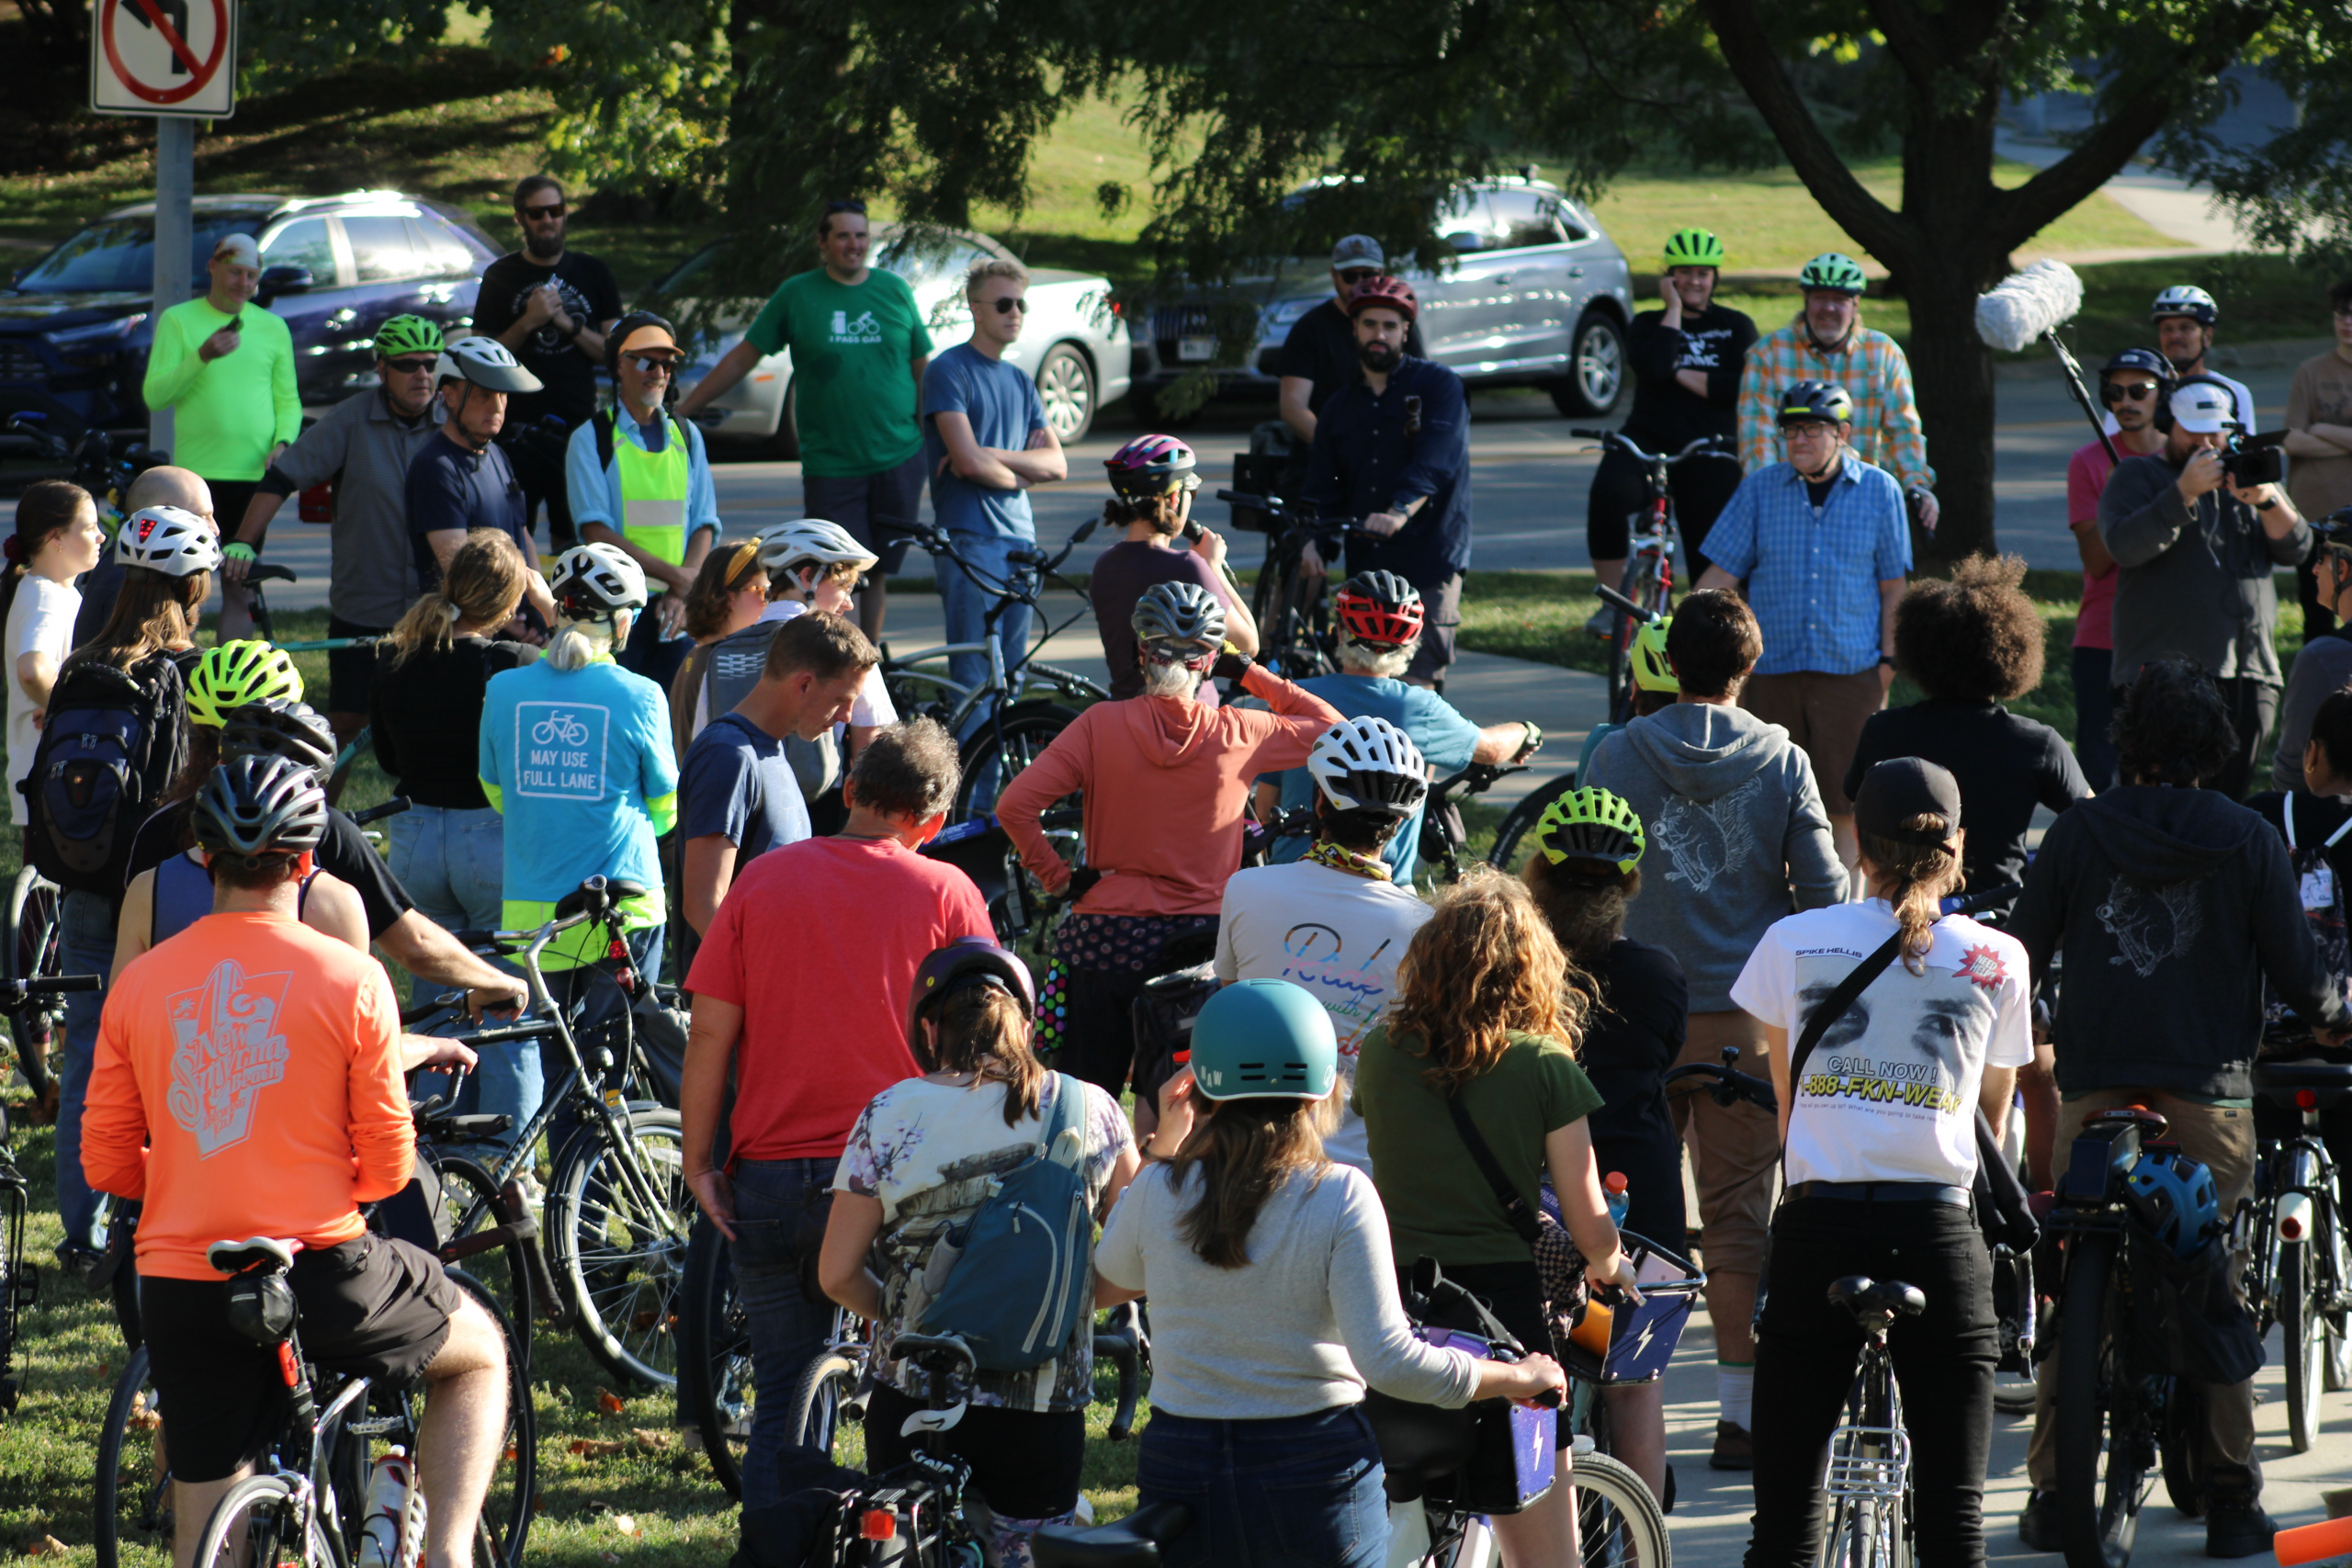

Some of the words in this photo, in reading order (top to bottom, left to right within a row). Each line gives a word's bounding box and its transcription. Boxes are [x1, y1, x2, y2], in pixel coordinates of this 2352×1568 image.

[836, 335, 860, 344] PASS
[862, 335, 882, 344] GAS
[531, 750, 559, 765] MAY
[561, 751, 588, 768] USE
[524, 771, 556, 787] FULL
[560, 773, 596, 790] LANE
[1283, 922, 1391, 995] Ride
[1795, 948, 1825, 956] SPIKE
[1826, 947, 1863, 959] HELLIS
[1976, 953, 1998, 971] NEED
[1969, 962, 1997, 981] HELP?
[186, 1020, 266, 1072] New
[230, 1063, 281, 1094] Beach
[1827, 1055, 1875, 1077] CALL
[1879, 1061, 1928, 1081] NOW
[1930, 1067, 1939, 1083] !
[168, 1036, 289, 1129] Smyrna
[1799, 1073, 1964, 1116] 1-888-FKN-WEAK
[1848, 1103, 1863, 1111] What
[1887, 1110, 1904, 1119] going
[1912, 1112, 1926, 1121] take
